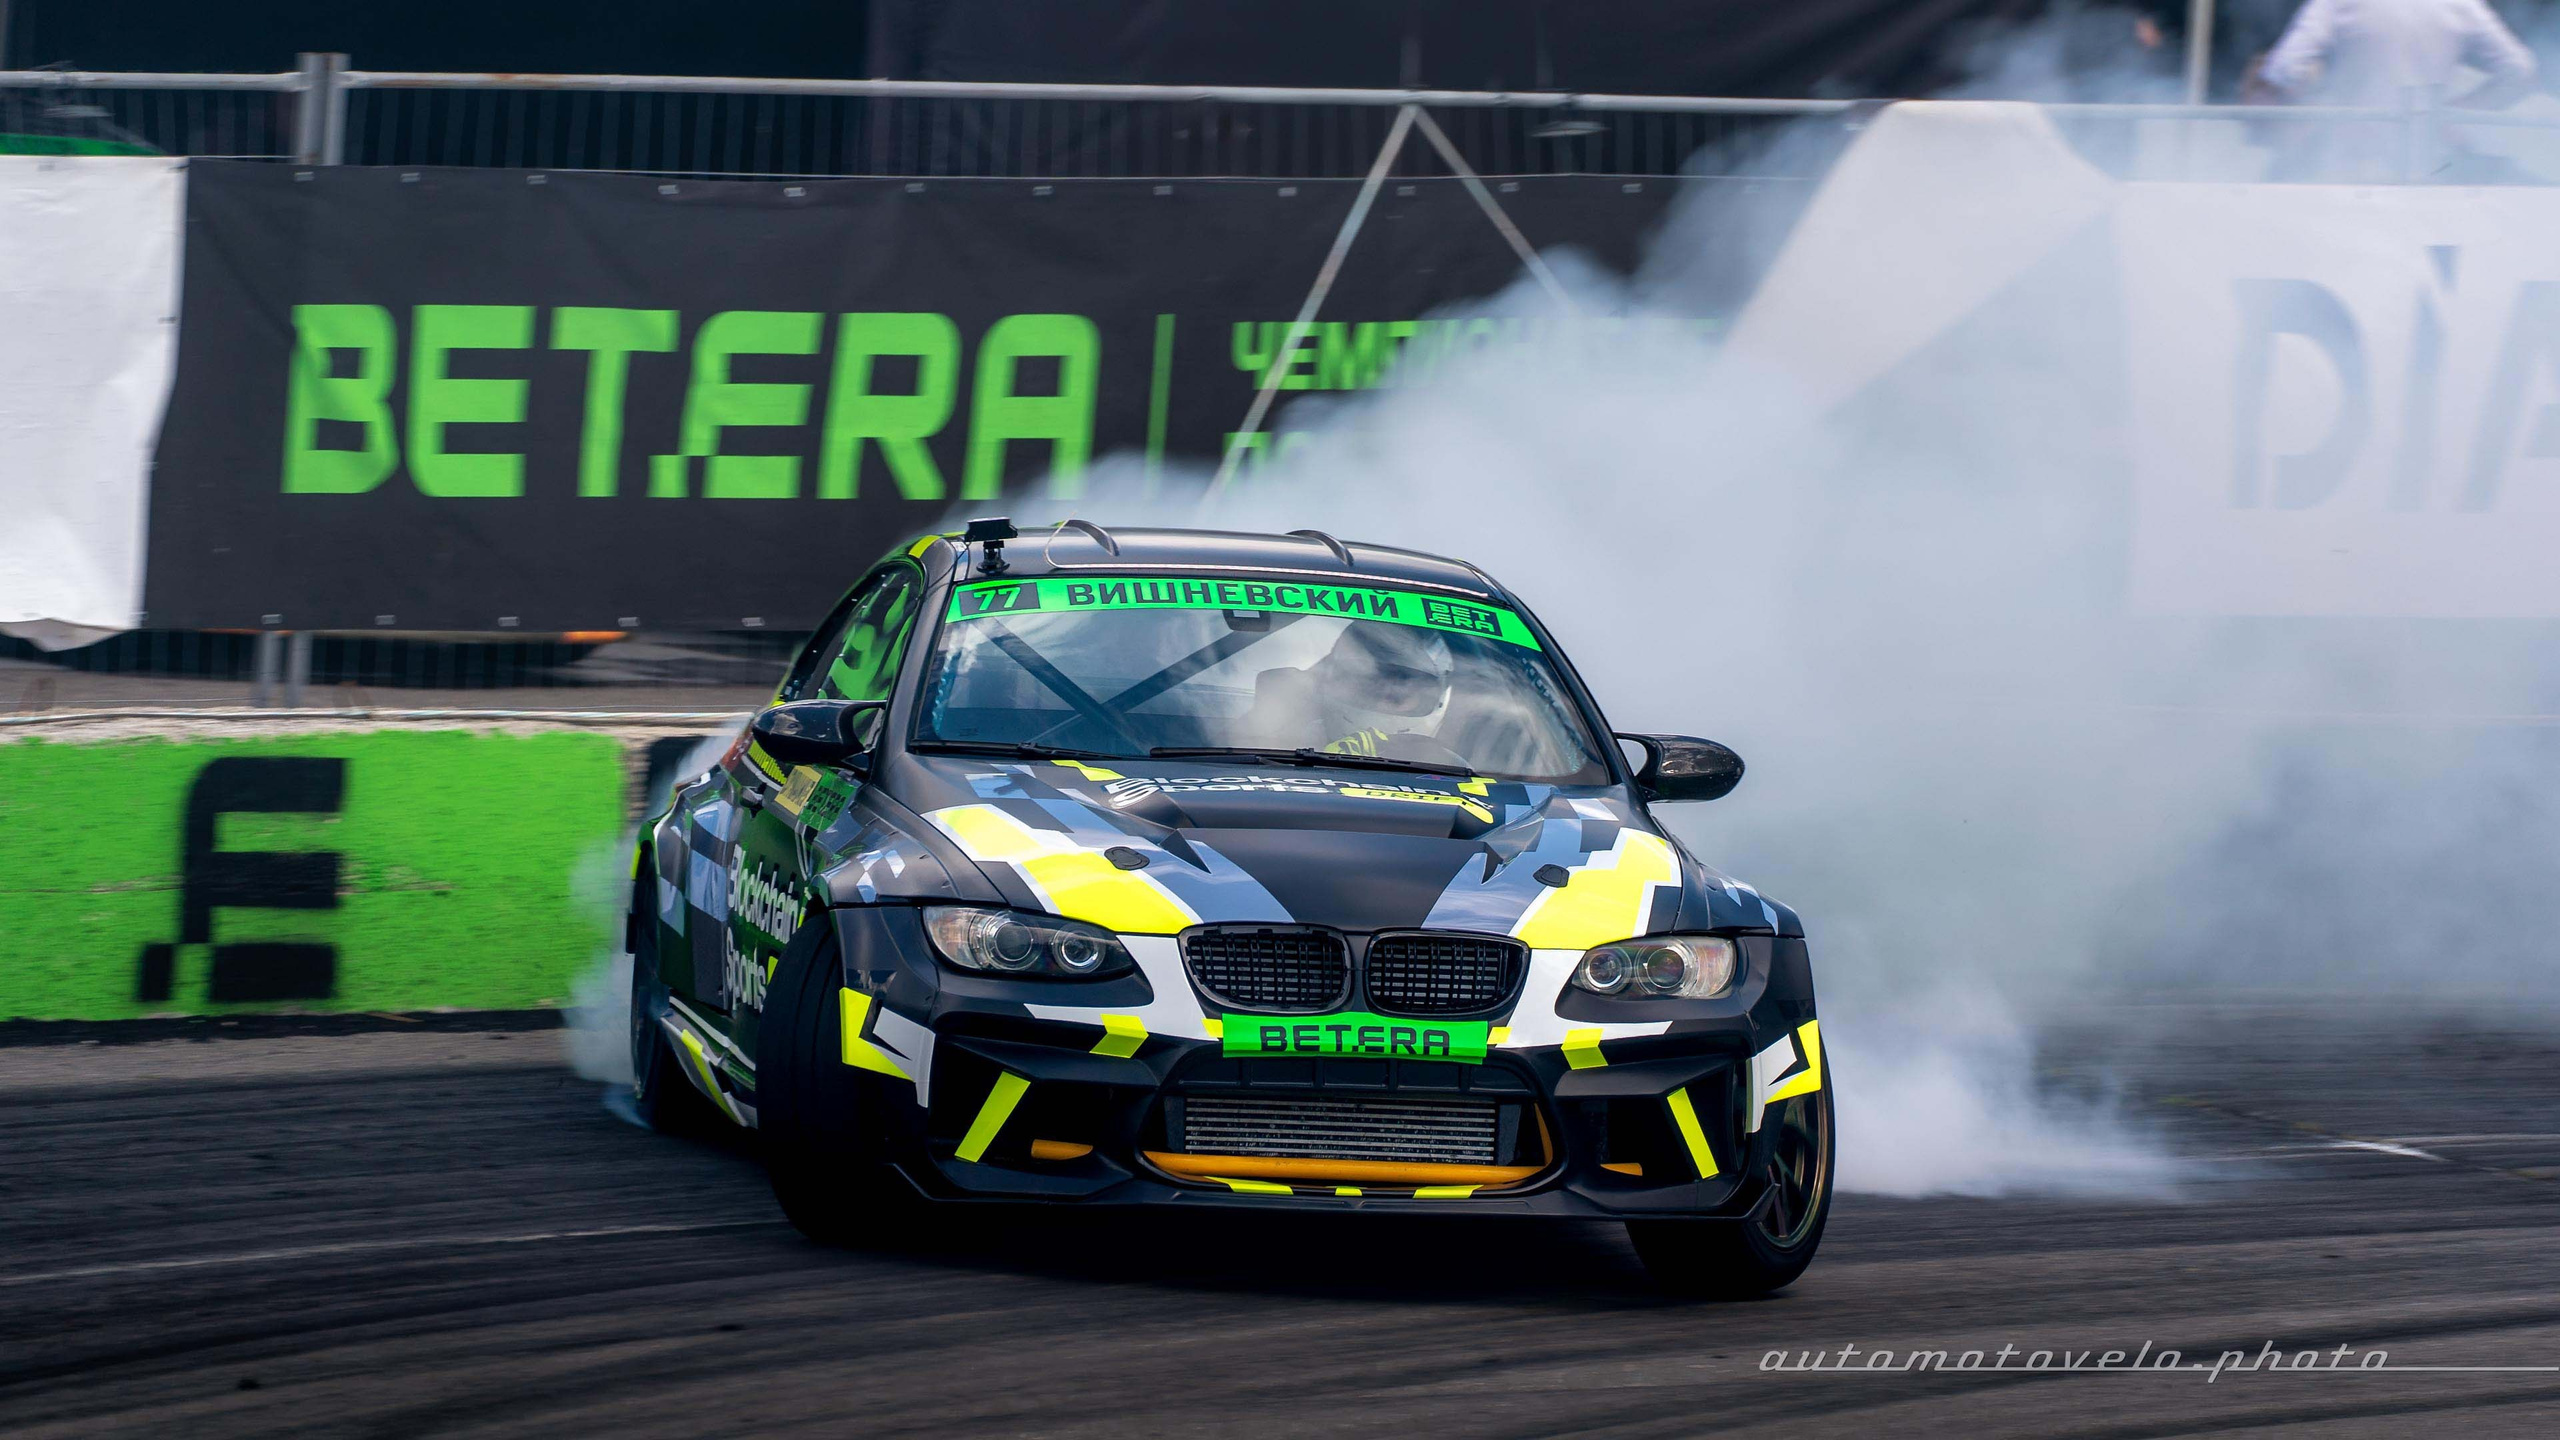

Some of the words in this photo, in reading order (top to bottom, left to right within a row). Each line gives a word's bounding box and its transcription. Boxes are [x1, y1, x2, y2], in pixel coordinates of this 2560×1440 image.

[973, 586, 1021, 612] 77
[1067, 581, 1400, 619] ВИШНЕВСКИЙ
[1428, 602, 1491, 621] BET
[1104, 776, 1452, 796] Blockchain
[1109, 784, 1328, 810] Sports
[728, 843, 799, 944] Blockchain
[726, 926, 767, 1014] Sports
